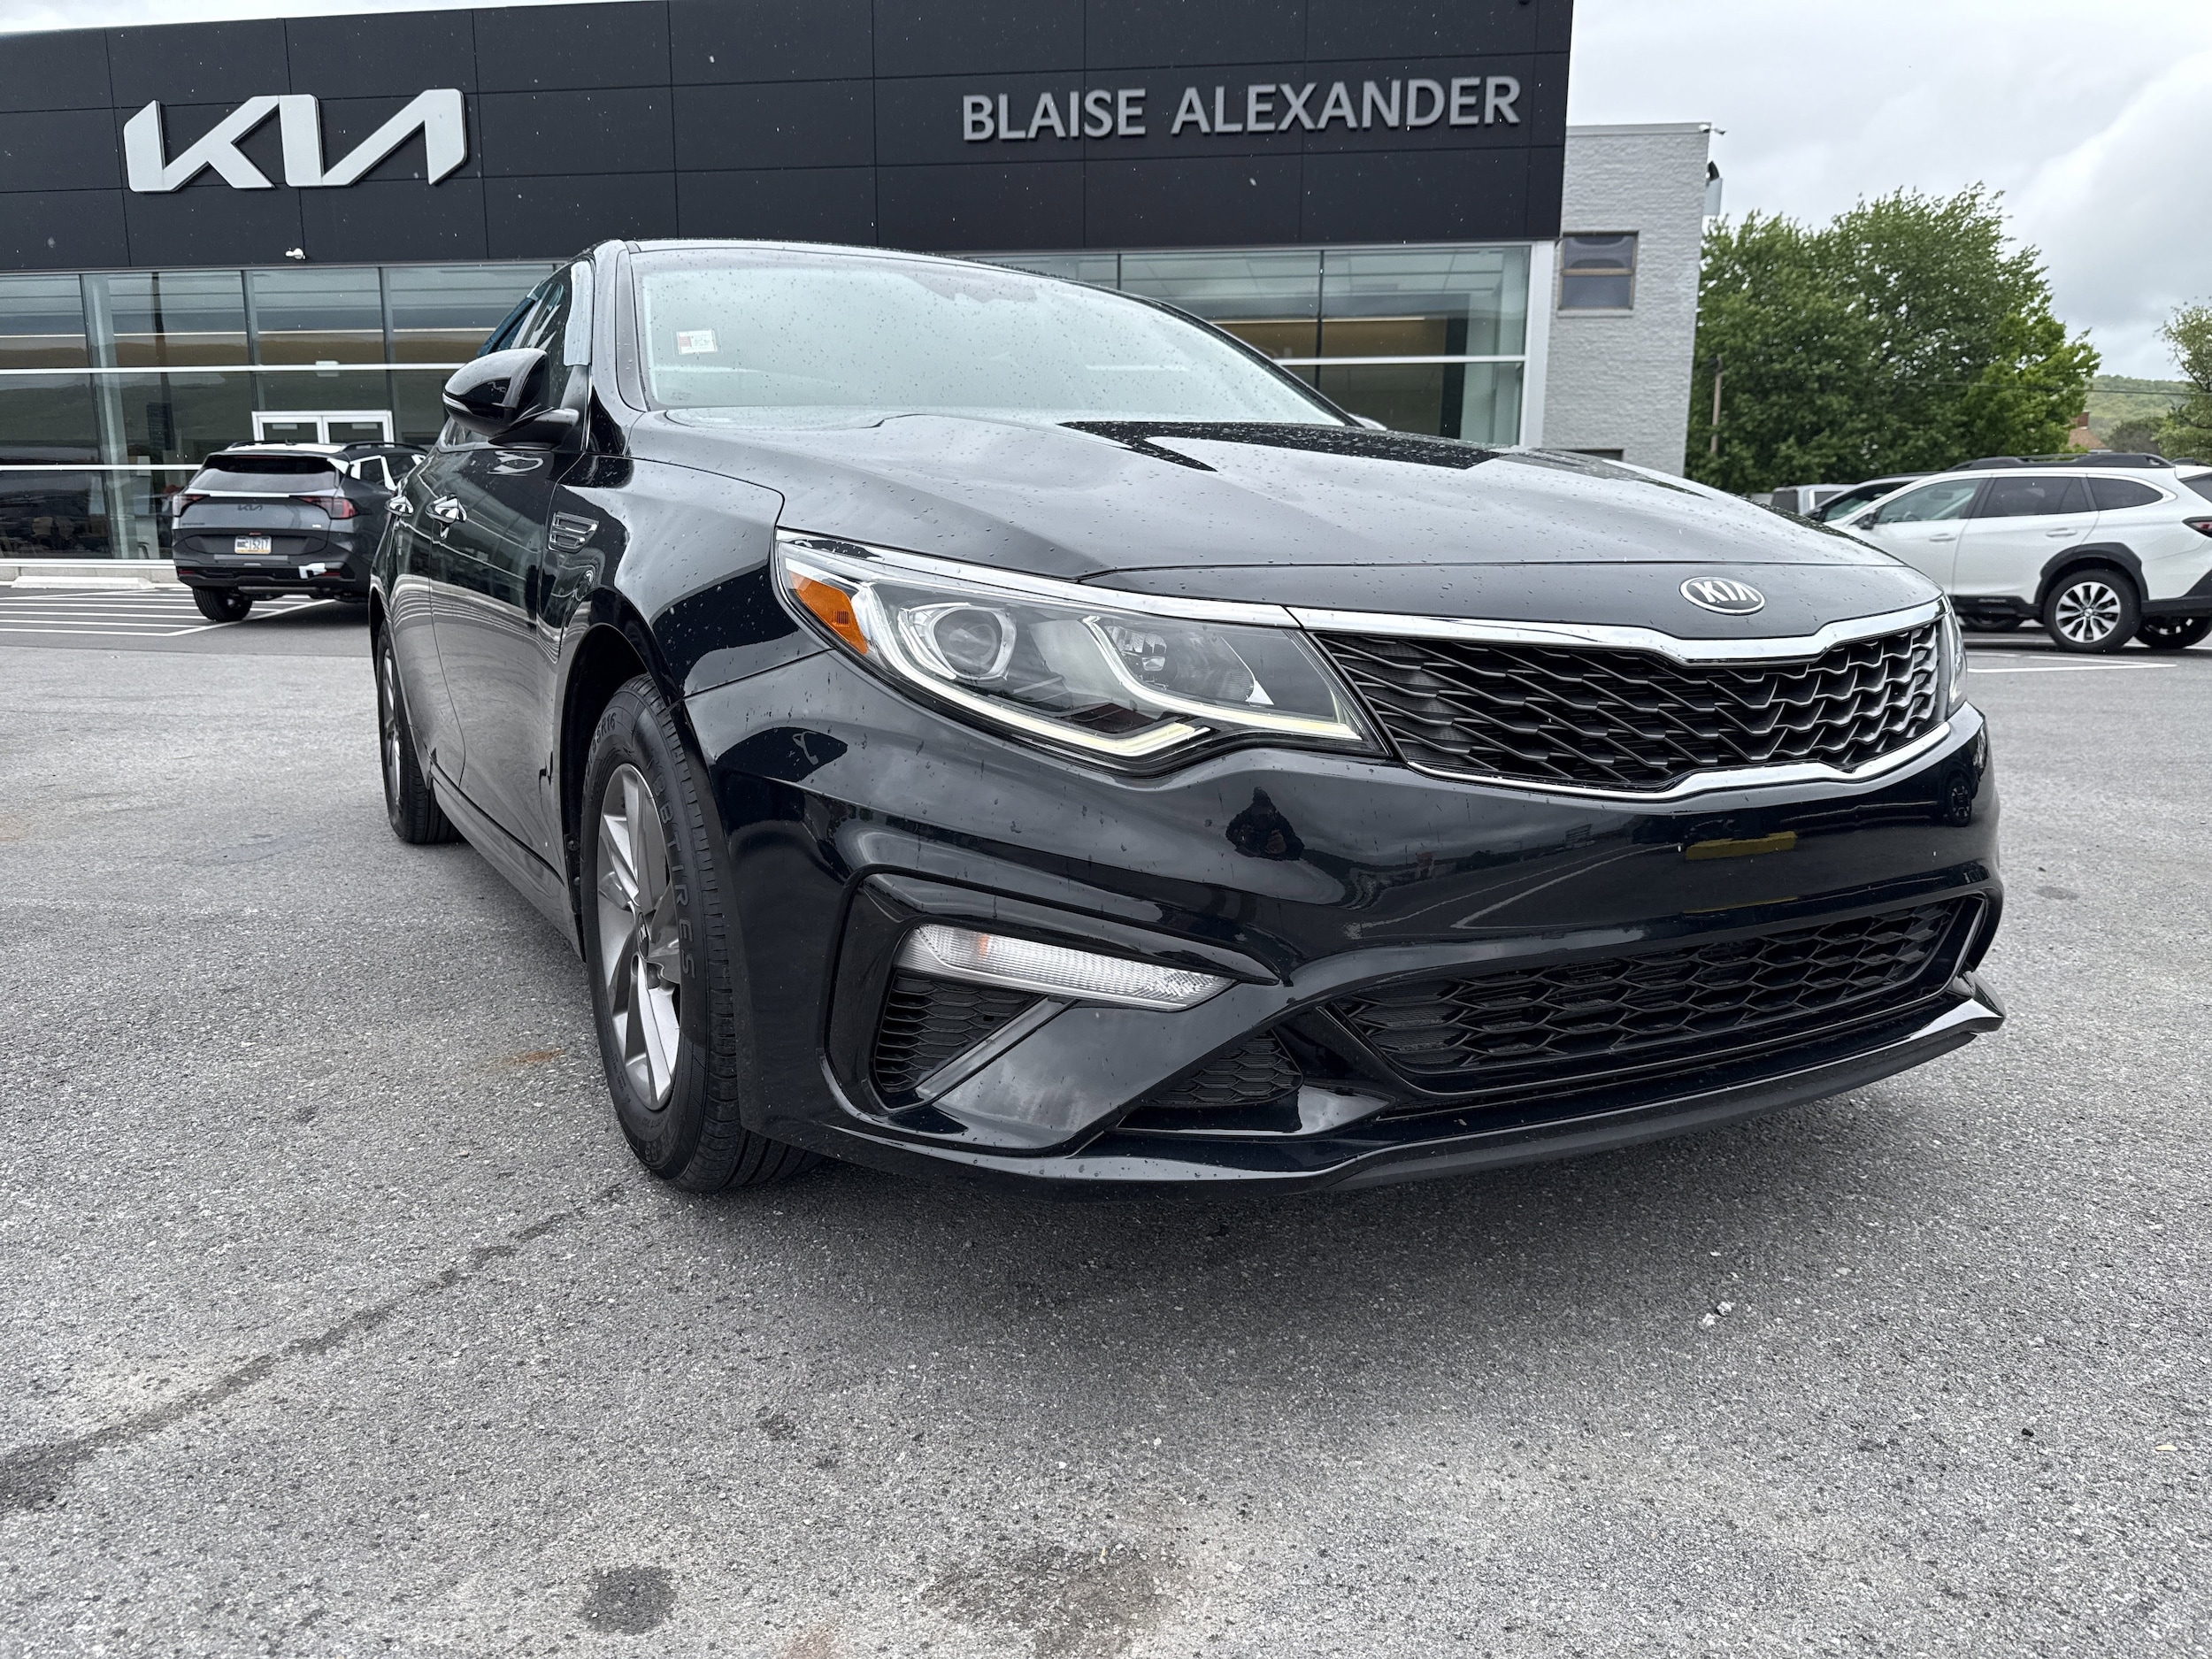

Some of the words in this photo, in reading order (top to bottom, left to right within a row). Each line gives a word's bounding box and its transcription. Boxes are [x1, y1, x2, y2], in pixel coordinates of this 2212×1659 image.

[124, 88, 467, 192] KIA
[962, 89, 1147, 142] BLAISE
[1170, 76, 1520, 135] ALEXANDER
[1691, 580, 1759, 603] KIA
